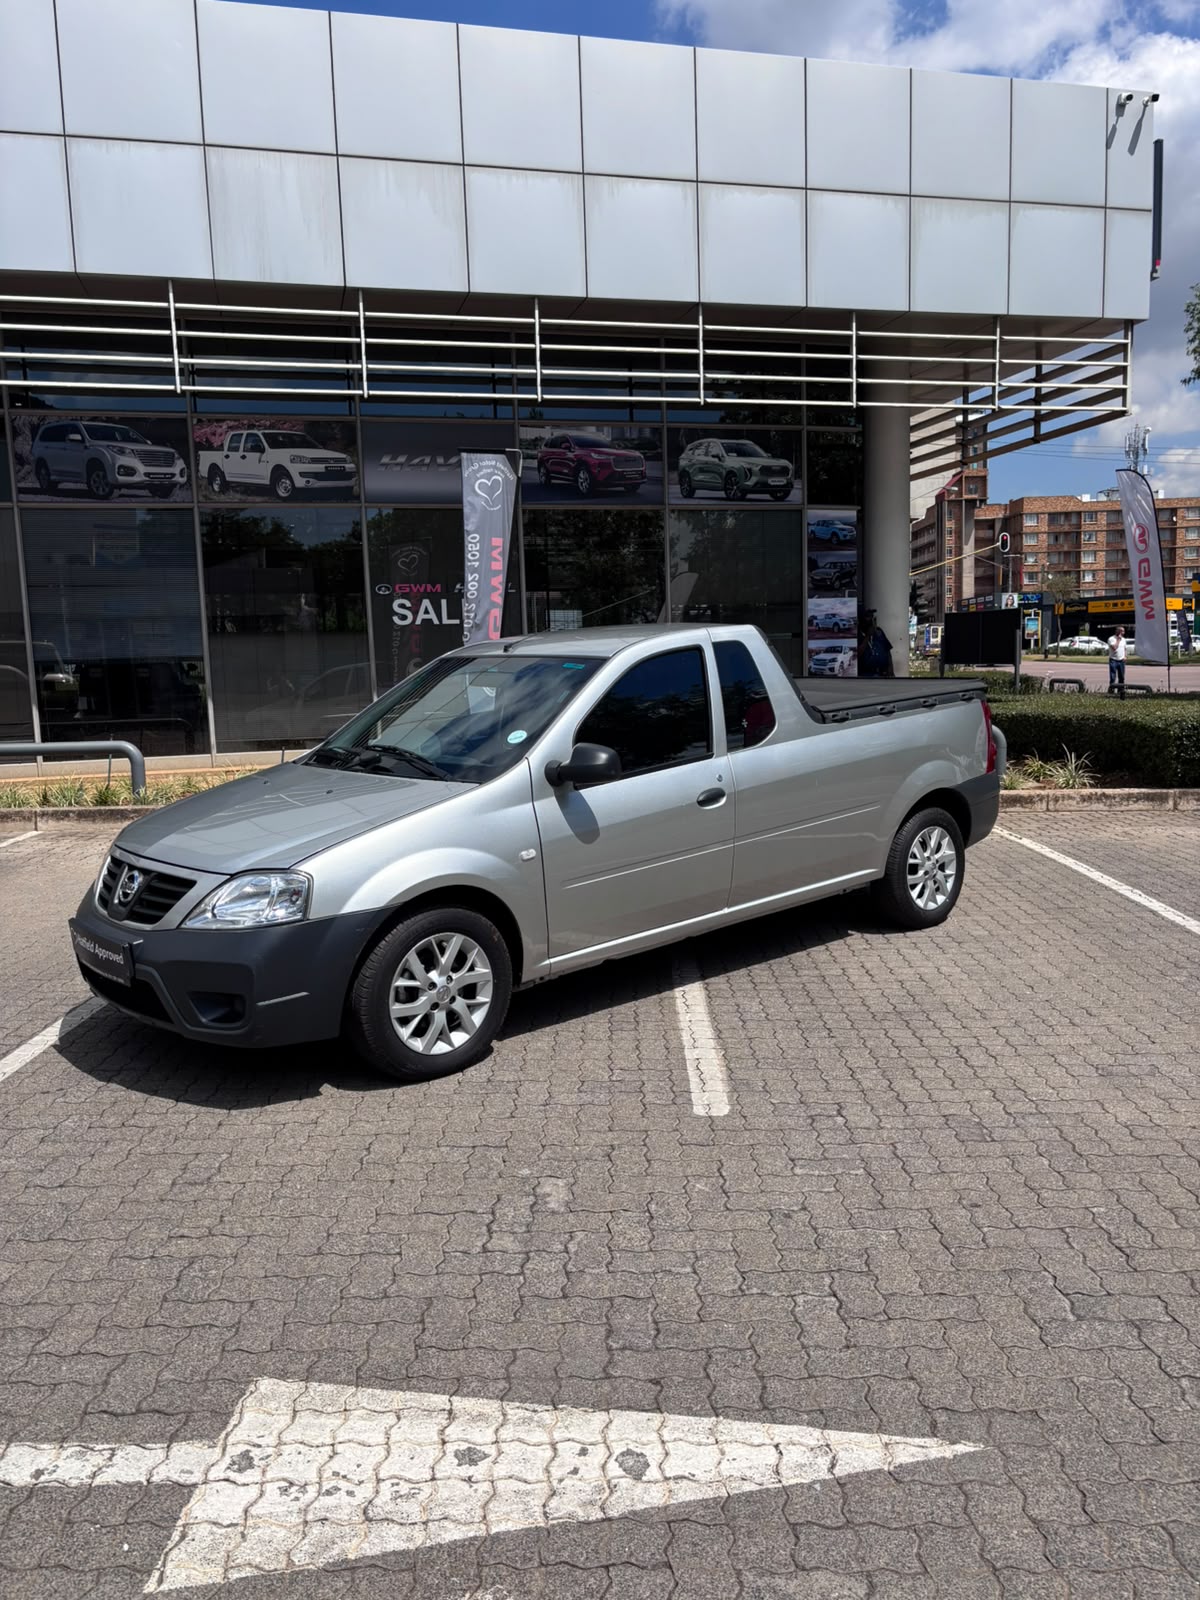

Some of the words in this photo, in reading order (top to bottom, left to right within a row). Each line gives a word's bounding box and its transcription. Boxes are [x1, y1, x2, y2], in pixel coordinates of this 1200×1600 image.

[379, 454, 461, 465] HAV
[394, 583, 441, 593] GWM
[392, 598, 462, 626] SAL
